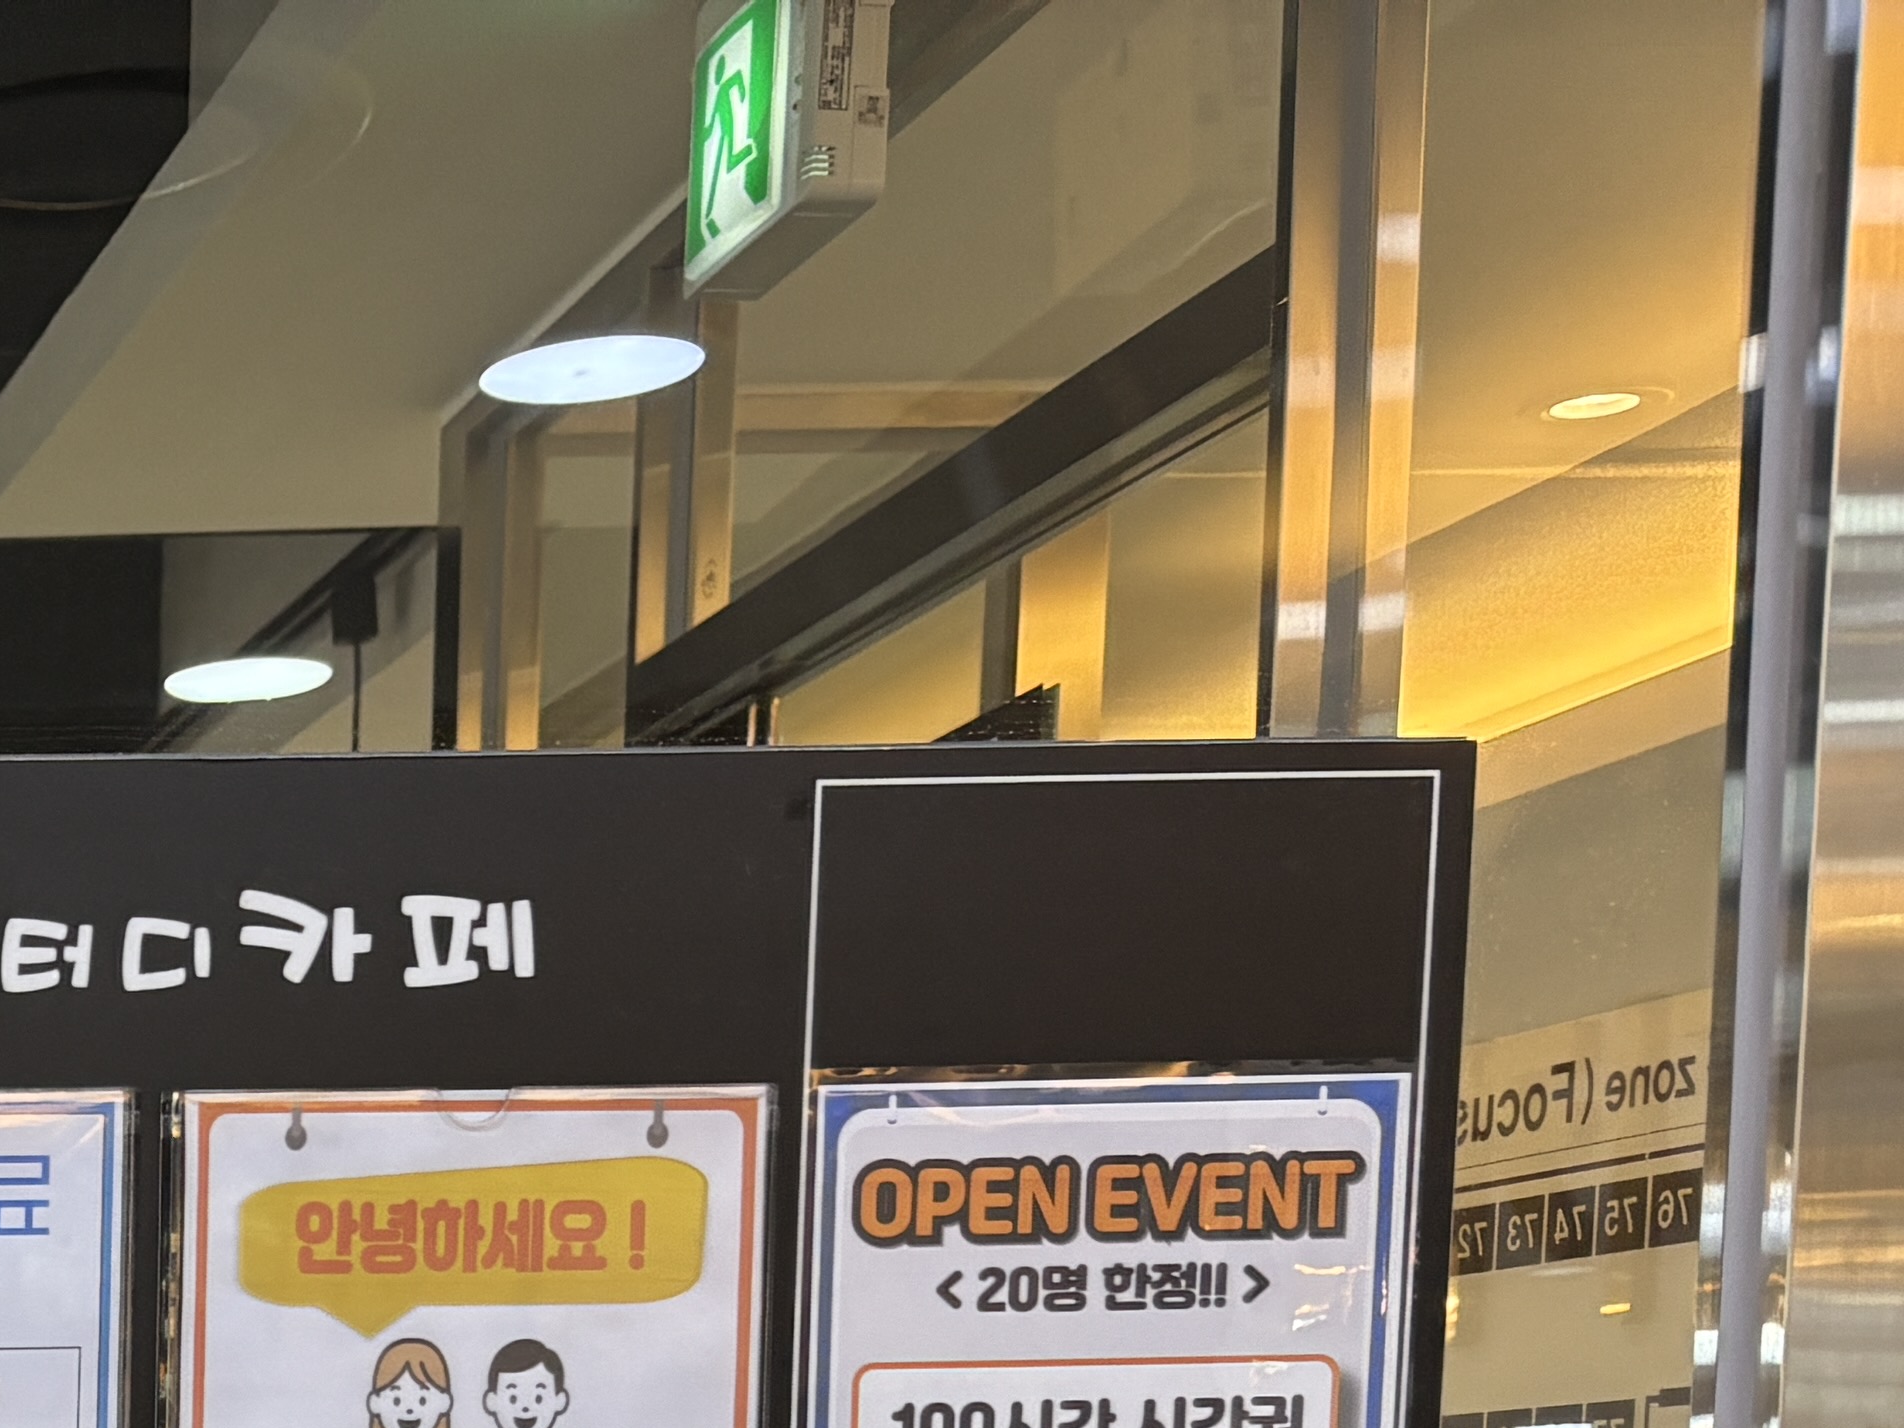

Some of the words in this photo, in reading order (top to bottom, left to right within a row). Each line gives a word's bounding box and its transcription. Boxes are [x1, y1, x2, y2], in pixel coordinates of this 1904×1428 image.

[295, 1198, 608, 1275] 안녕하세요
[852, 1155, 1080, 1247] OPEN
[1087, 1151, 1365, 1244] EVENT
[977, 1264, 1088, 1313] 20명
[1102, 1262, 1227, 1312] 한정!!
